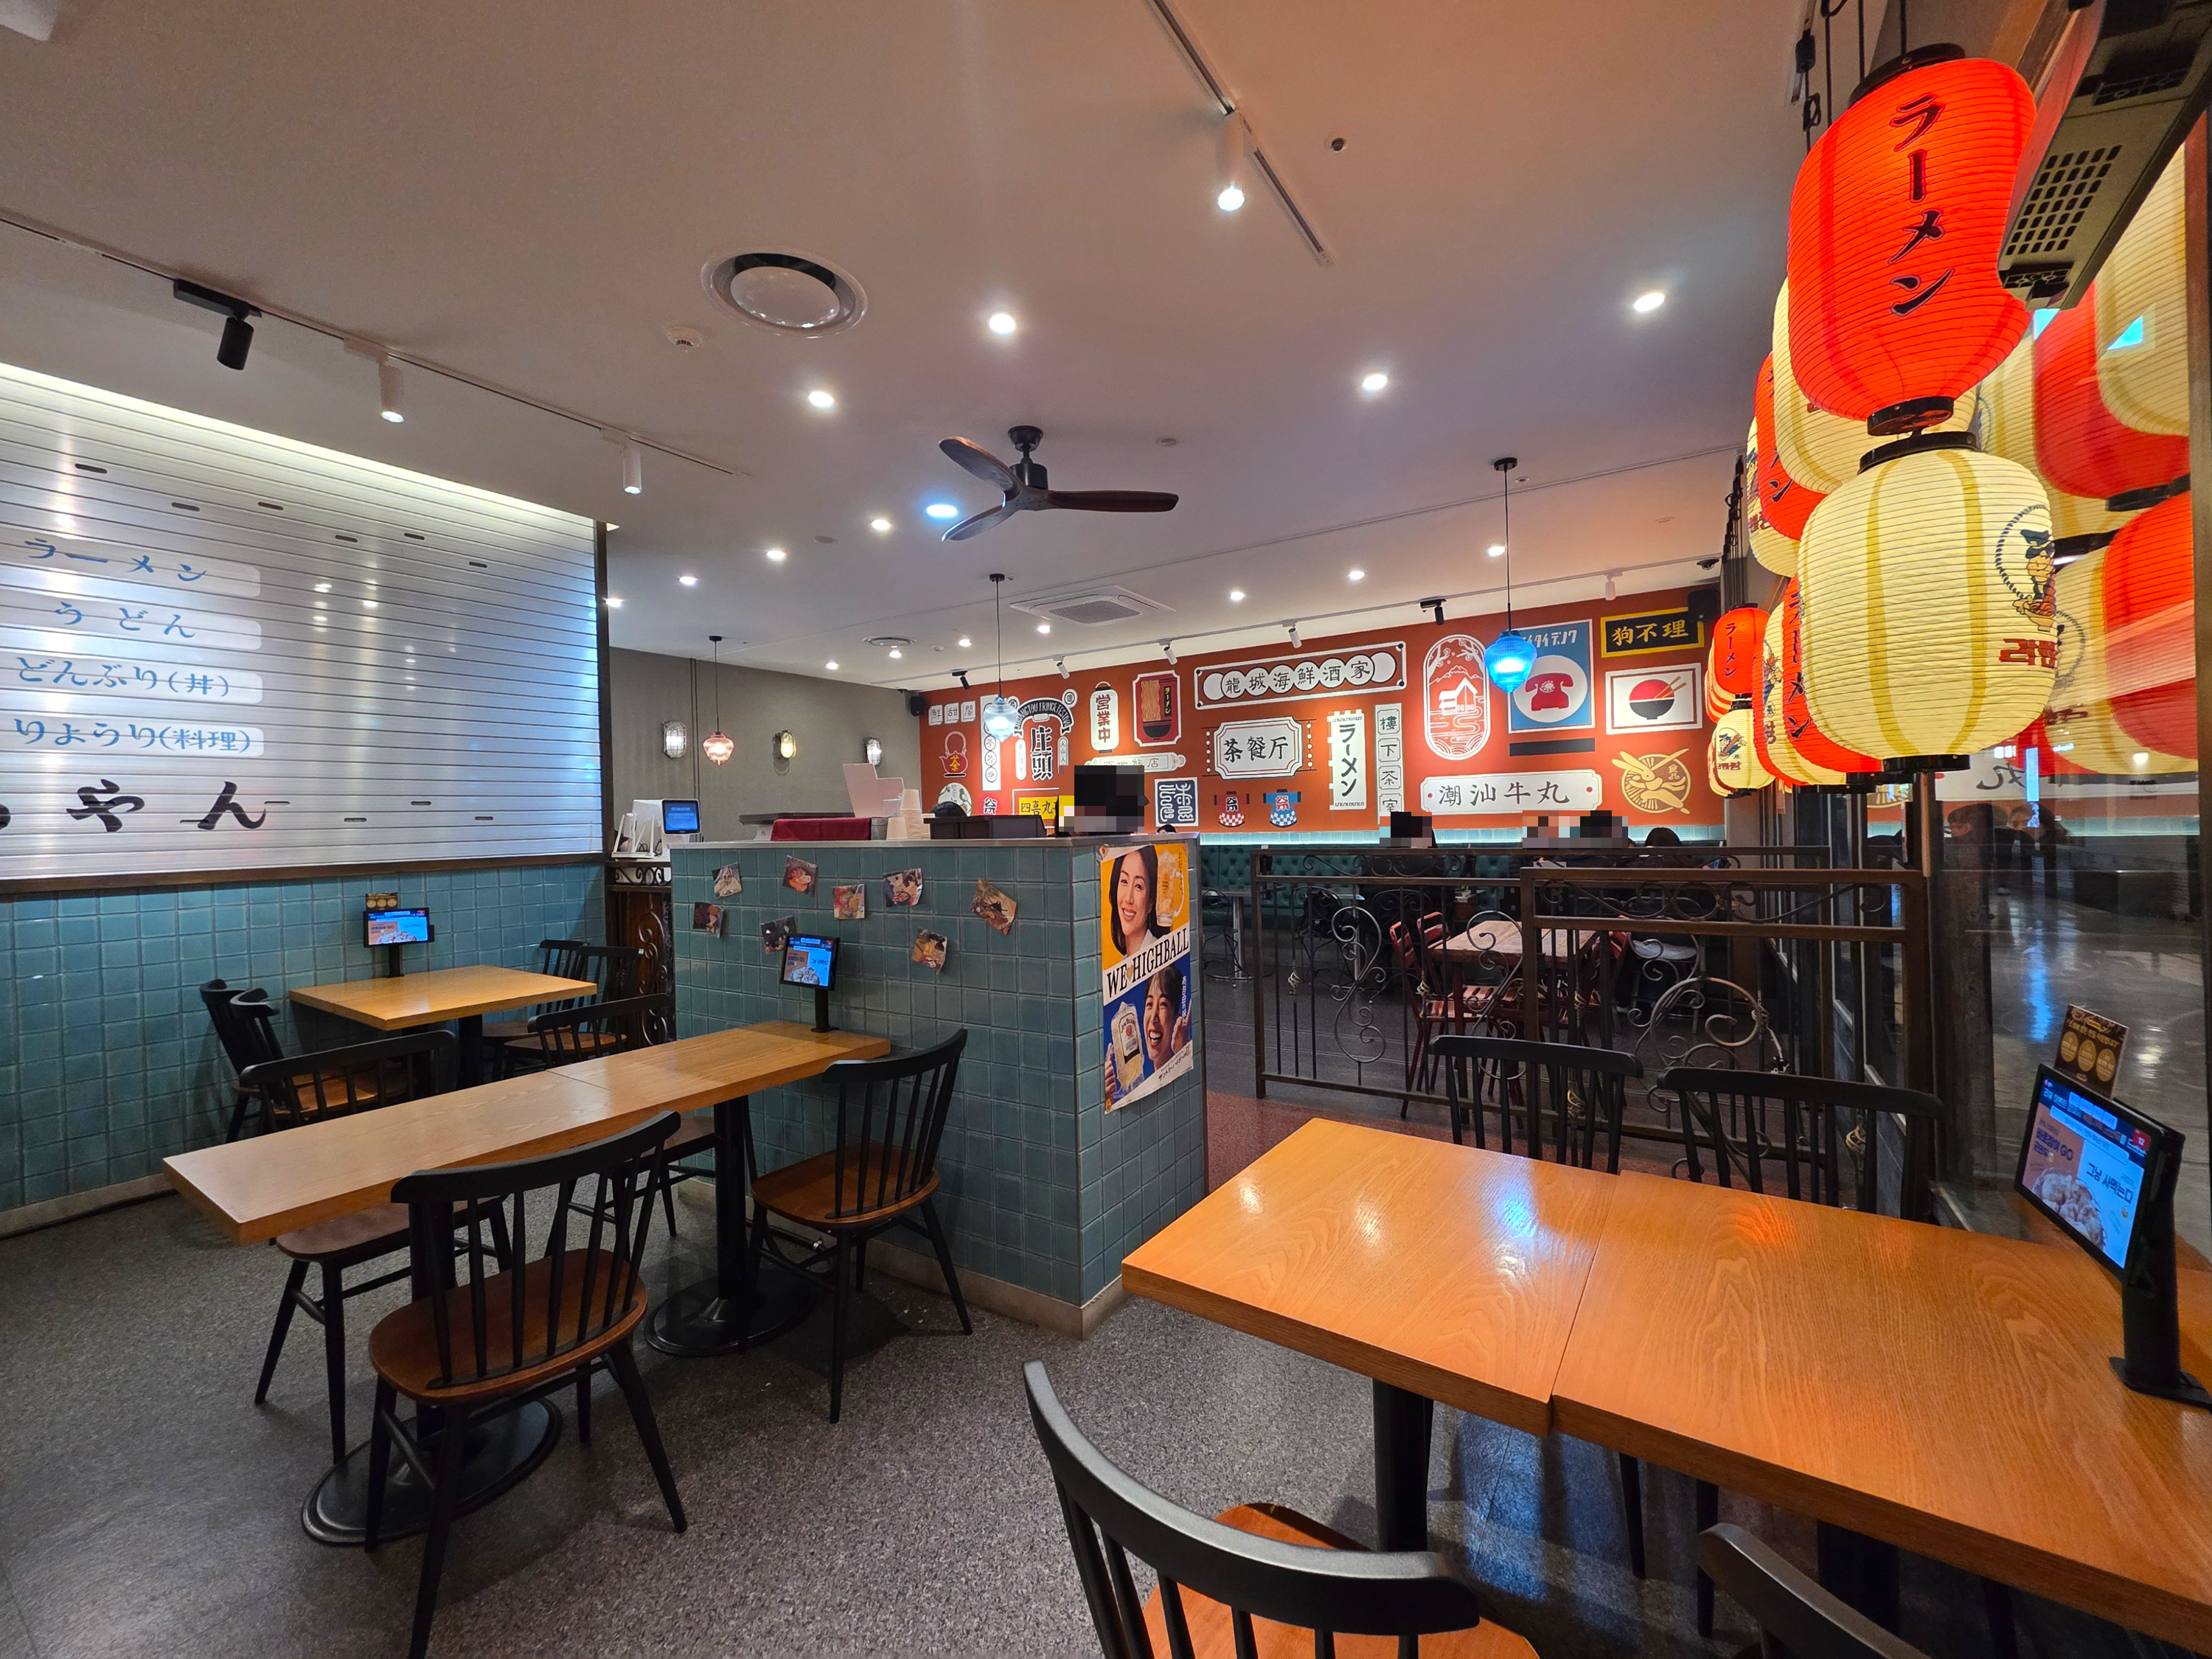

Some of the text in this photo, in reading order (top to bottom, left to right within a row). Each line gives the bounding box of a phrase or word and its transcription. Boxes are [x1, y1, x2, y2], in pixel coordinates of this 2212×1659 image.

[1888, 93, 1955, 318] ラーメン
[24, 538, 208, 582] ラーメン
[55, 601, 196, 639] うどん
[1611, 619, 1689, 647] 狗不理
[1724, 622, 1737, 678] ラーメン
[1225, 660, 1371, 695] 龍城海鮮酒家
[1096, 694, 1111, 743] 営業中
[949, 754, 961, 772] 茶
[1222, 735, 1289, 764] 茶餐厅
[1338, 723, 1358, 797] ラーメン
[1668, 763, 1680, 780] 食品
[1225, 796, 1239, 812] 祭
[1275, 795, 1290, 811] 祭
[1438, 780, 1571, 807] 潮汕牛丸
[1107, 928, 1189, 998] WE HIGHBALL
[2060, 1144, 2073, 1161] GO
[2086, 1162, 2103, 1182] 그냥
